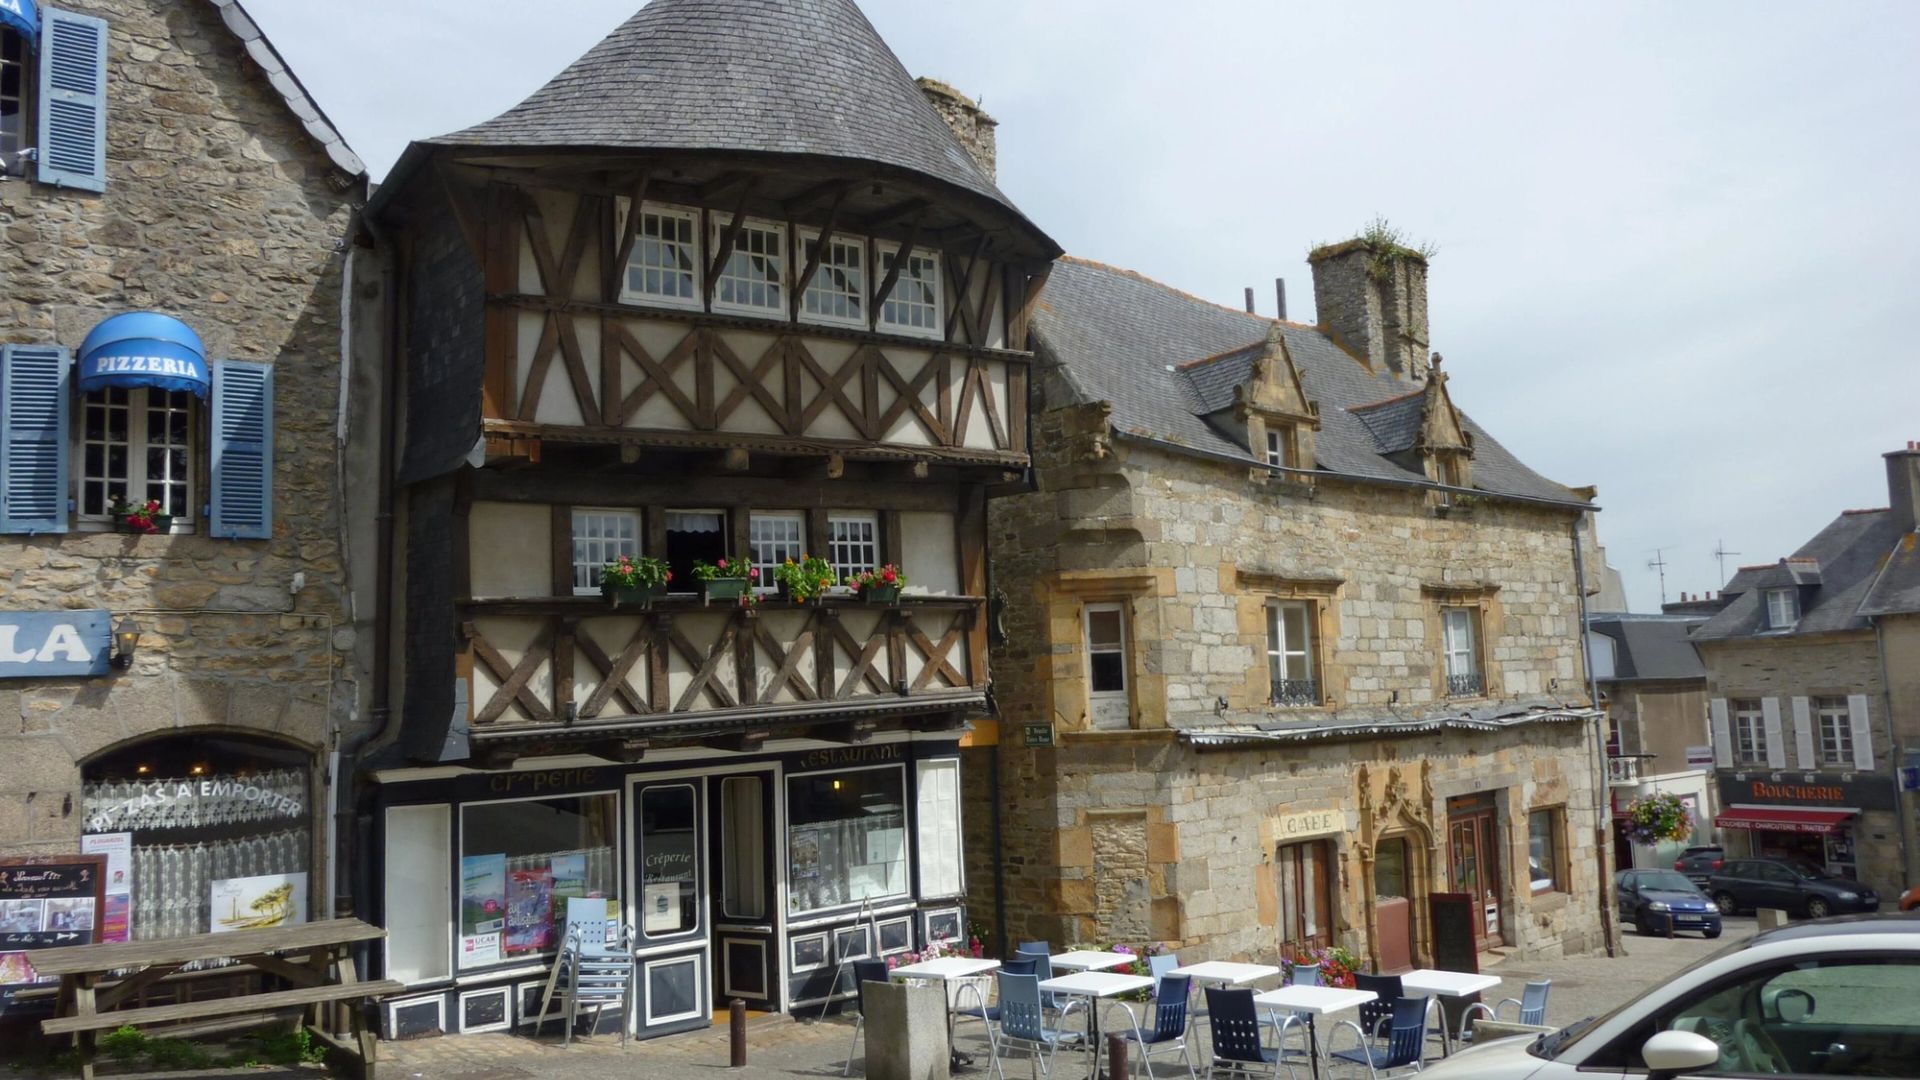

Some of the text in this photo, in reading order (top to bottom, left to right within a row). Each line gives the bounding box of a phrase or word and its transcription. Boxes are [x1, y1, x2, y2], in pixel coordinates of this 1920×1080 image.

[96, 356, 199, 378] PIZZERIA
[91, 787, 166, 832] PIZAS
[201, 780, 302, 818] EMPORTER
[1801, 823, 1832, 832] TRAITEUR
[646, 851, 691, 867] Crêperie
